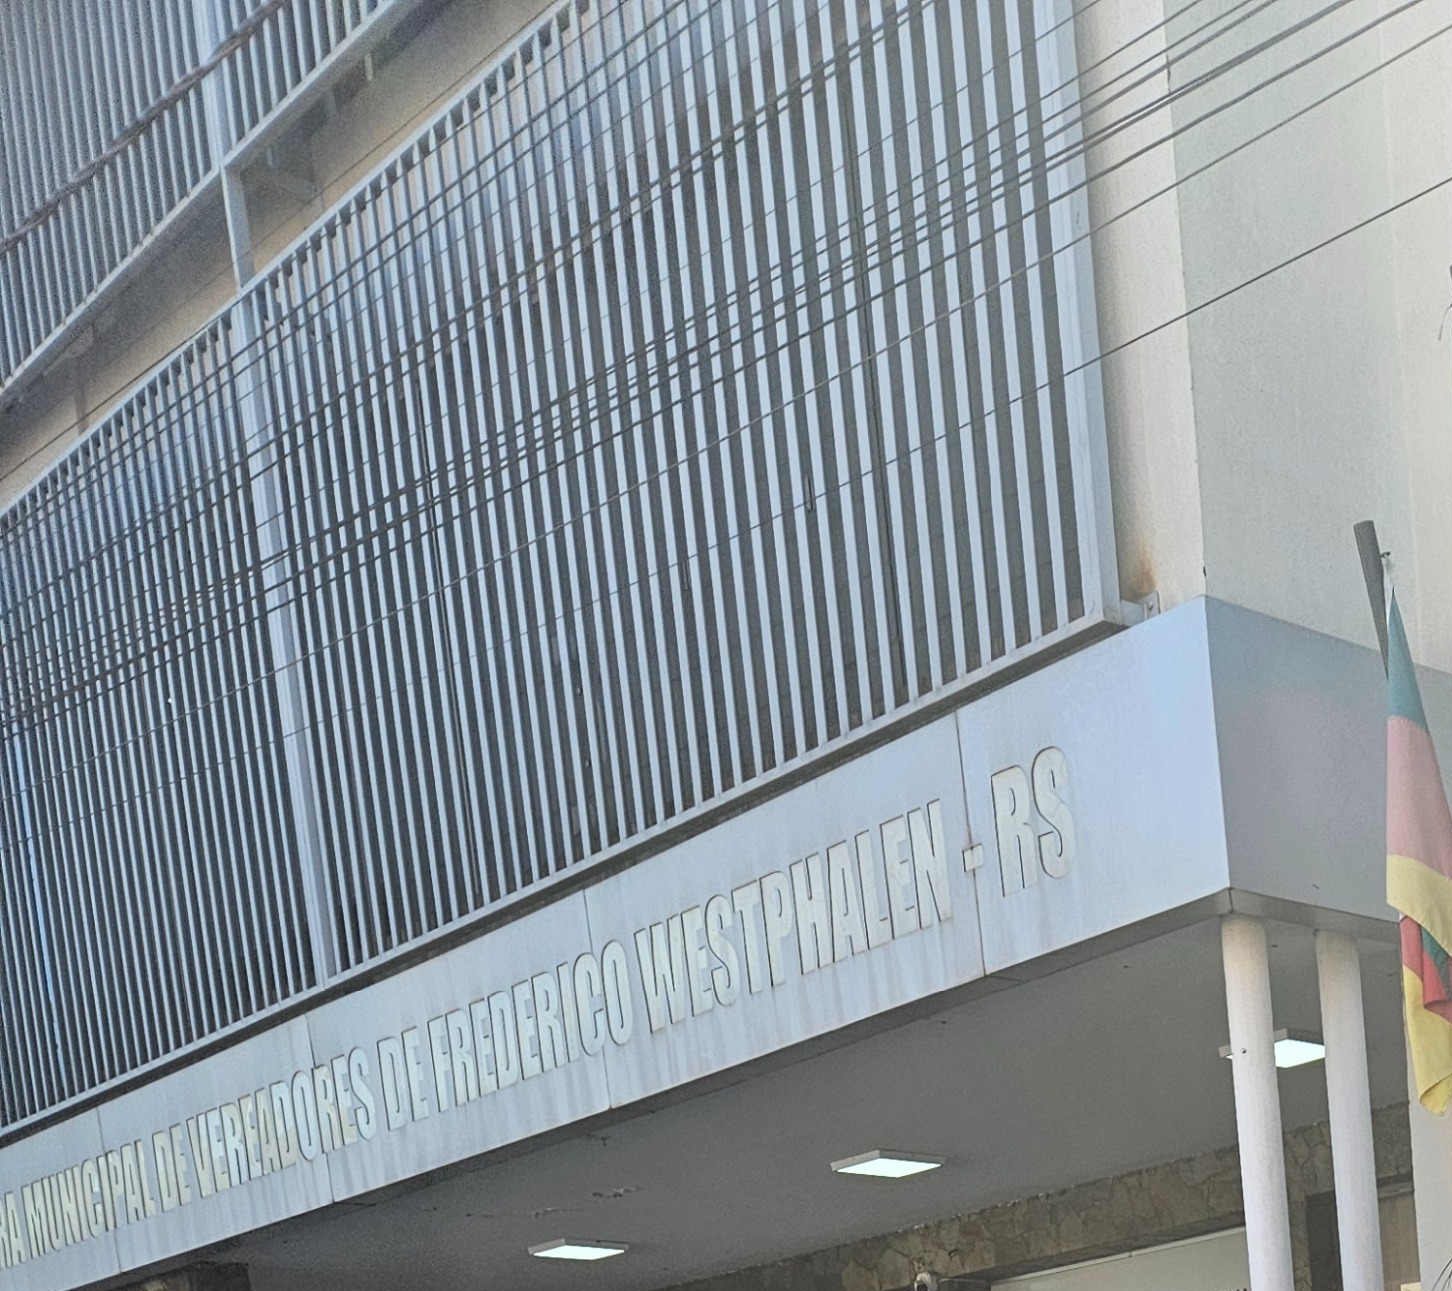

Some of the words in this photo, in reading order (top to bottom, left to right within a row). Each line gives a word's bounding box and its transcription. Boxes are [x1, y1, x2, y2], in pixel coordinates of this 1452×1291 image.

[21, 1139, 156, 1259] MUNICIPAL
[152, 1123, 192, 1213] DE
[186, 1046, 376, 1199] VEREADORES
[376, 1026, 430, 1132] DE
[427, 939, 634, 1113] FREDERICO
[633, 799, 954, 1034] WESTPHALEN
[990, 745, 1077, 898] RS
